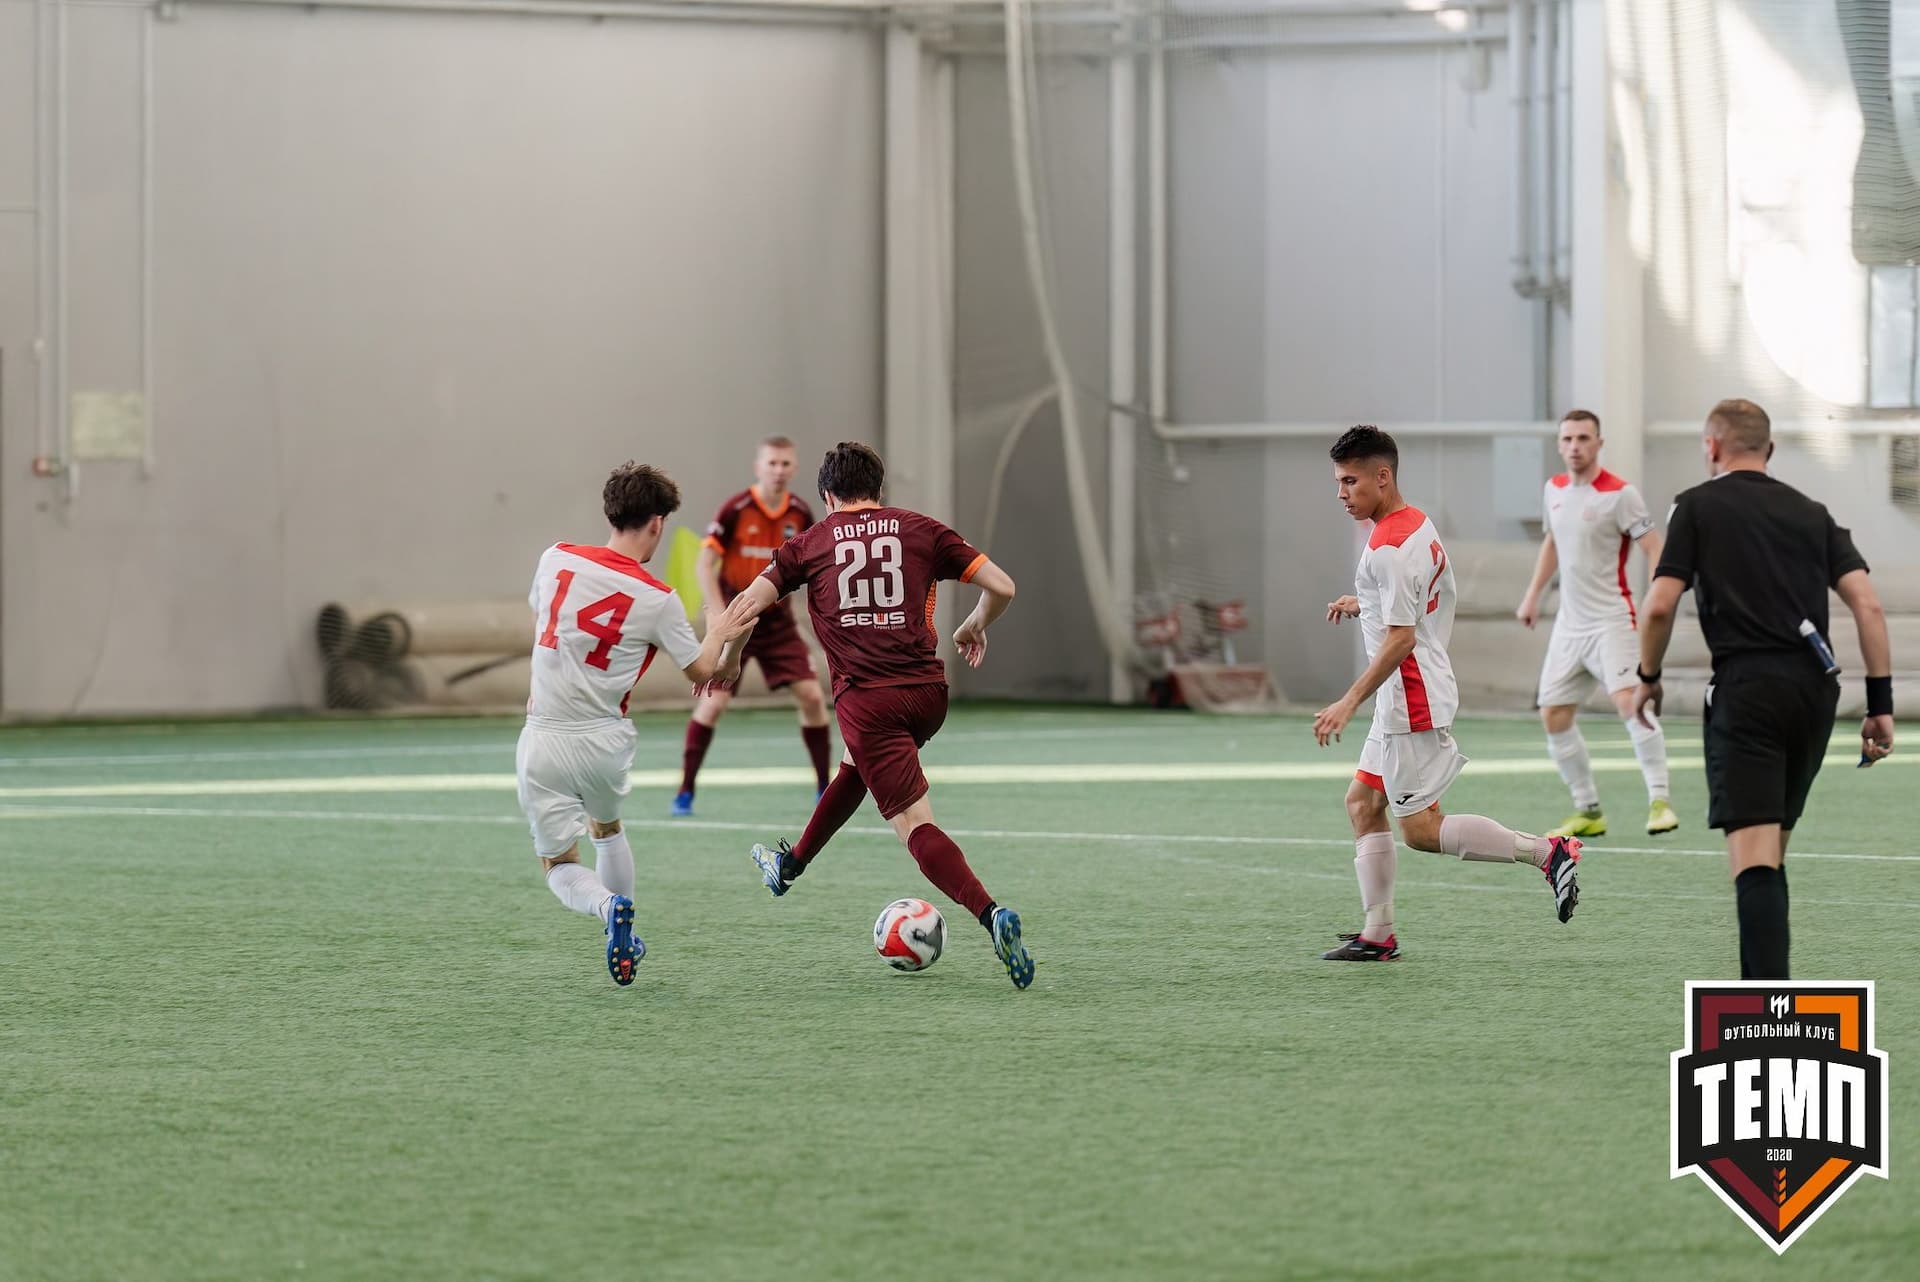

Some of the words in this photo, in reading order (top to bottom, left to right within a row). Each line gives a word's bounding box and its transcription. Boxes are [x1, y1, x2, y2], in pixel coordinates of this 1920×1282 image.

[833, 519, 900, 541] ВОРОНА
[834, 536, 905, 609] 23
[538, 569, 636, 671] 14
[840, 612, 906, 627] SEUS
